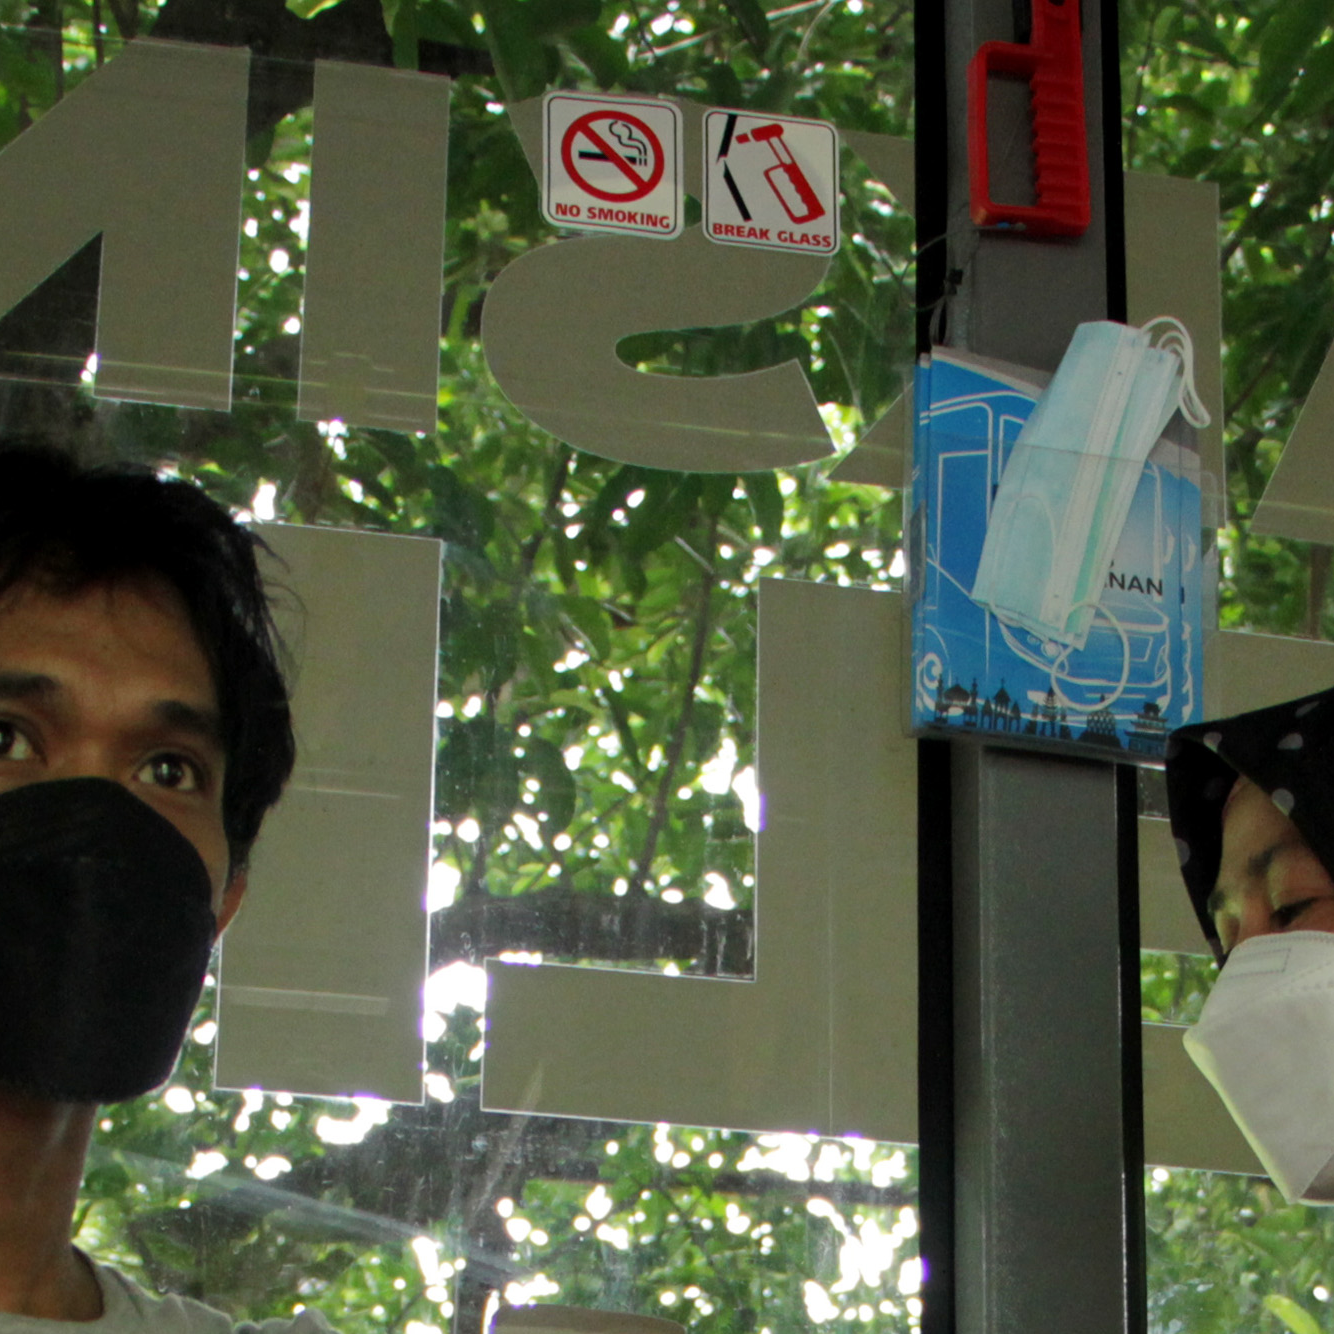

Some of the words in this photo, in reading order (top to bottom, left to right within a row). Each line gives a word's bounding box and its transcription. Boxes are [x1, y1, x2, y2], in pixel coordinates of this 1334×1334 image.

[555, 202, 581, 217] NO
[586, 206, 671, 229] SMOKING
[712, 222, 771, 241] BREAK
[777, 230, 832, 248] GLASS
